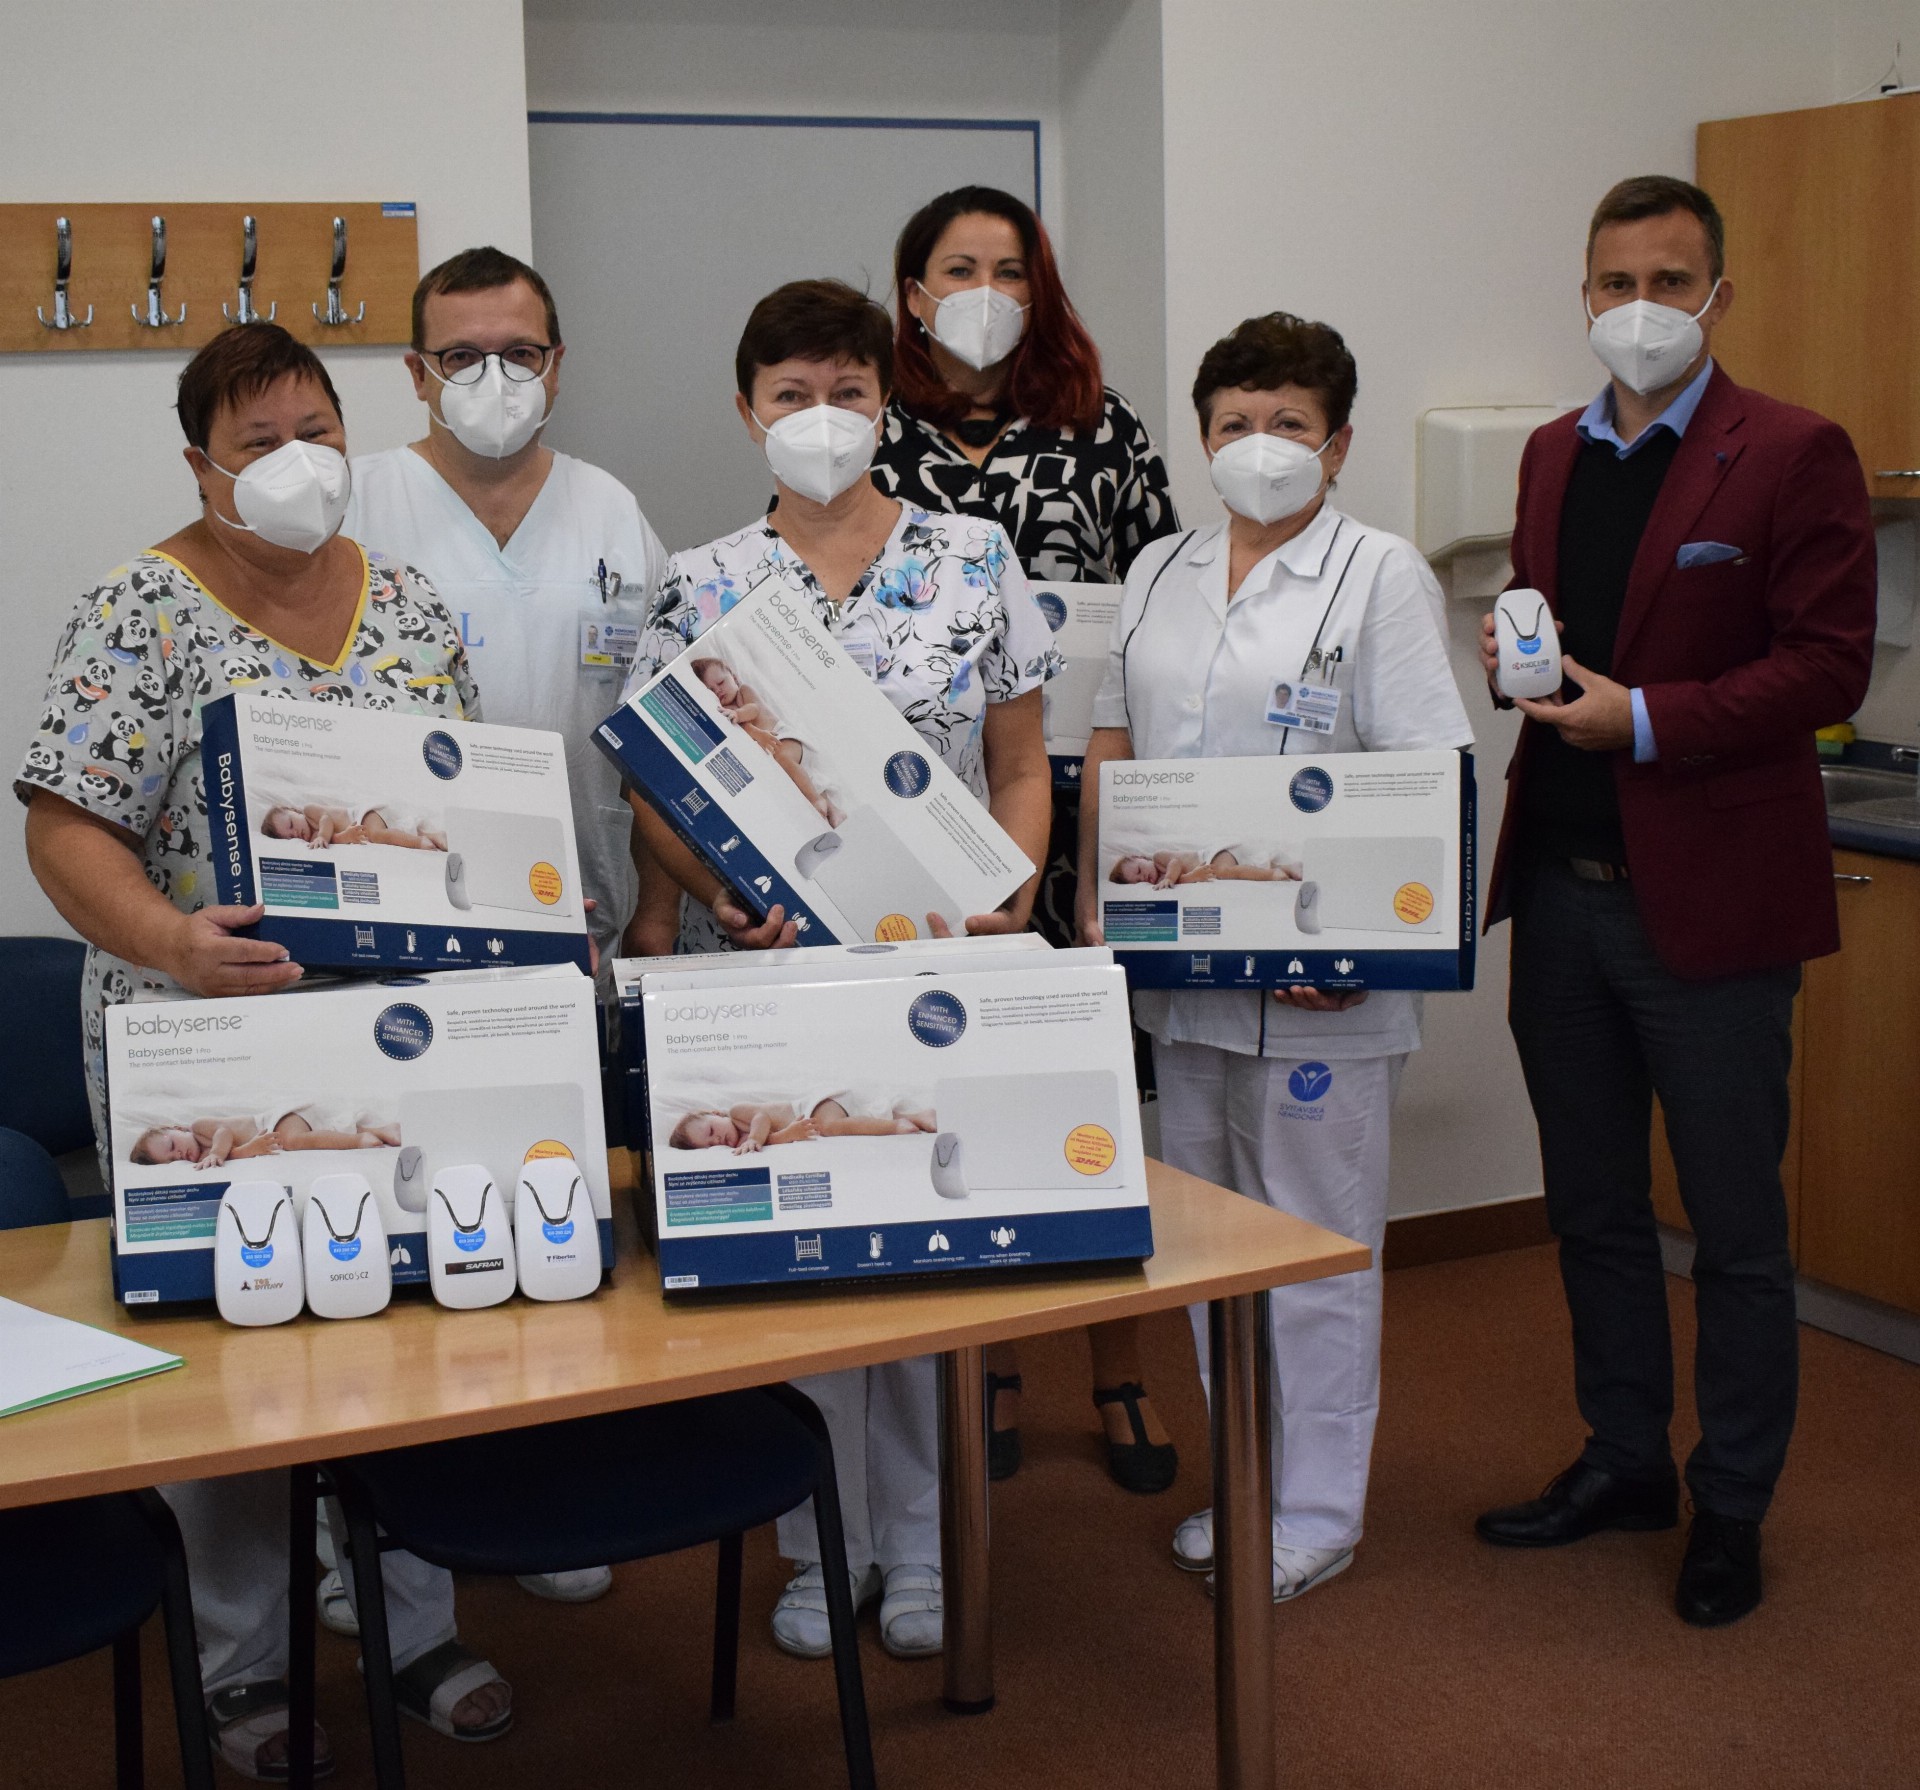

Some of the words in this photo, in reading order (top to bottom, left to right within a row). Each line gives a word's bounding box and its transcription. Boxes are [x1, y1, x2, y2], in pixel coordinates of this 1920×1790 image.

[754, 607, 792, 649] Babysense
[768, 590, 836, 668] babysense
[249, 705, 333, 731] babysense
[253, 734, 300, 747] Babysense
[899, 759, 918, 789] ENHANCED
[909, 763, 920, 779] WITH
[1113, 769, 1195, 788] babysense
[1112, 795, 1158, 804] Babysense
[218, 752, 242, 877] Babysense
[234, 892, 242, 906] Pr
[1464, 833, 1473, 942] Babysense
[482, 1007, 513, 1015] technology
[664, 1001, 779, 1024] babysense
[929, 1005, 948, 1014] WITH
[396, 1017, 415, 1028] WITH
[917, 1012, 957, 1024] ENHANCED
[126, 1014, 243, 1038] babysense
[384, 1025, 424, 1038] ENHANCED
[916, 1020, 957, 1033] SENSITIVITY
[382, 1033, 423, 1046] SENSITIVITY
[666, 1033, 730, 1045] Babysense
[128, 1046, 193, 1060] Babysense
[717, 1044, 732, 1052] baby
[733, 1042, 763, 1051] breathing
[180, 1058, 196, 1066] baby
[196, 1056, 226, 1065] breathing
[227, 1054, 252, 1063] monitor
[465, 1261, 502, 1270] SAFRAN
[330, 1273, 354, 1282] SOFICO
